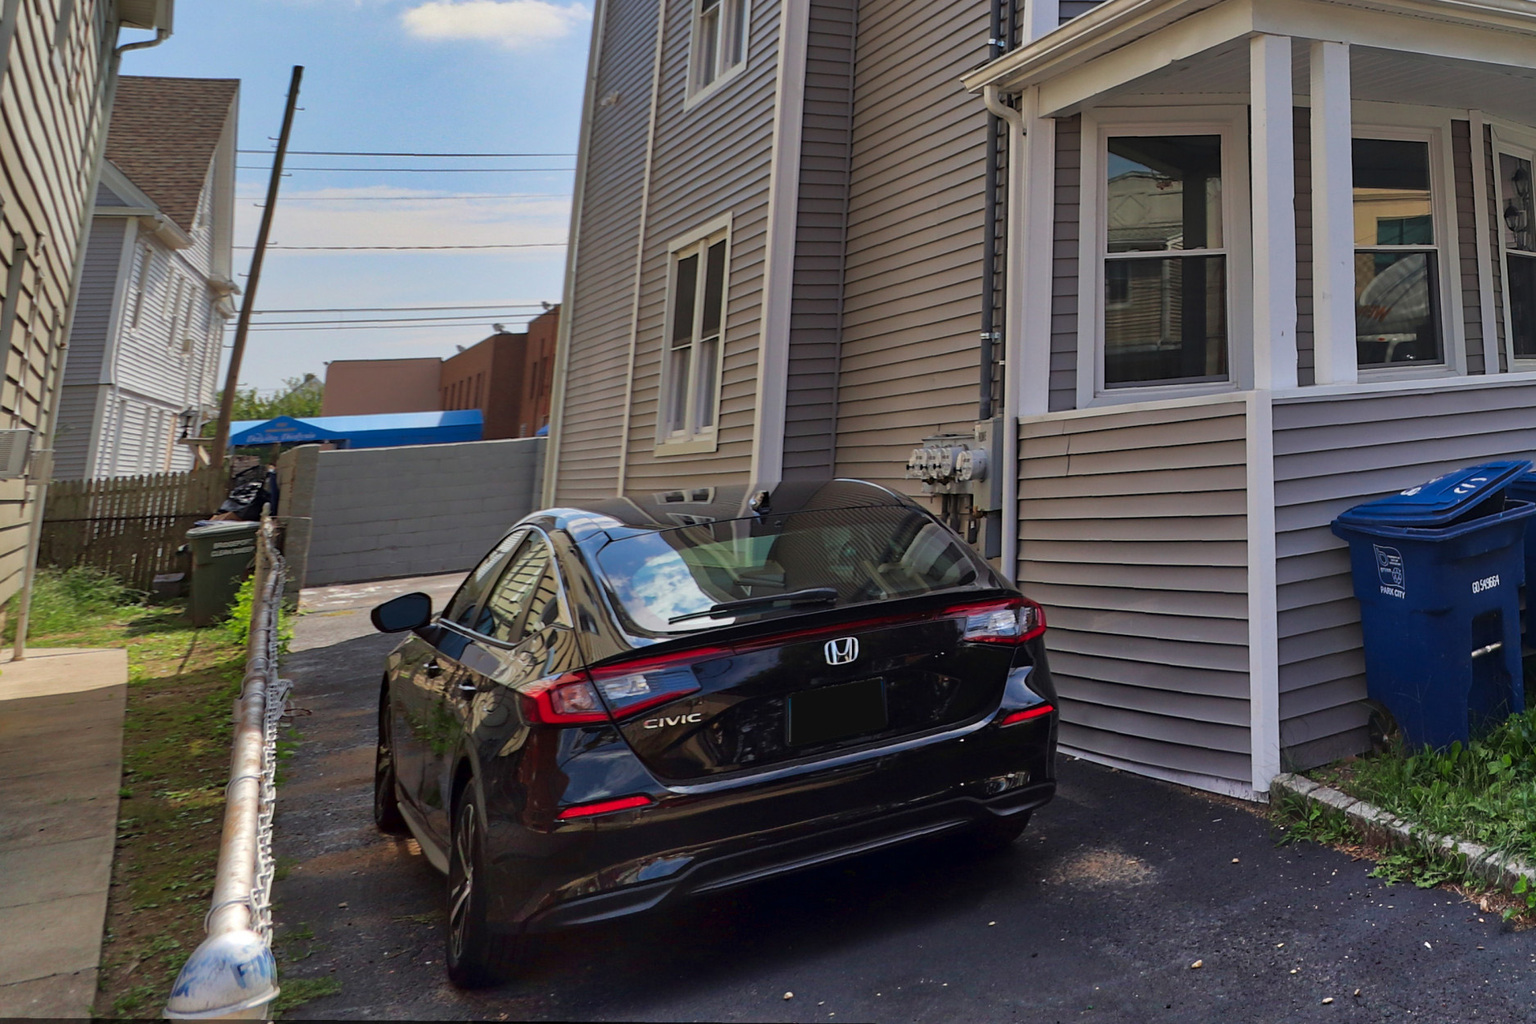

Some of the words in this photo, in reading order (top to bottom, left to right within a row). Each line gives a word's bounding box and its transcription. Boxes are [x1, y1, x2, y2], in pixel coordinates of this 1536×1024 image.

[1380, 585, 1394, 596] PARK
[1394, 588, 1406, 599] CITY
[643, 713, 702, 729] CIVIC
